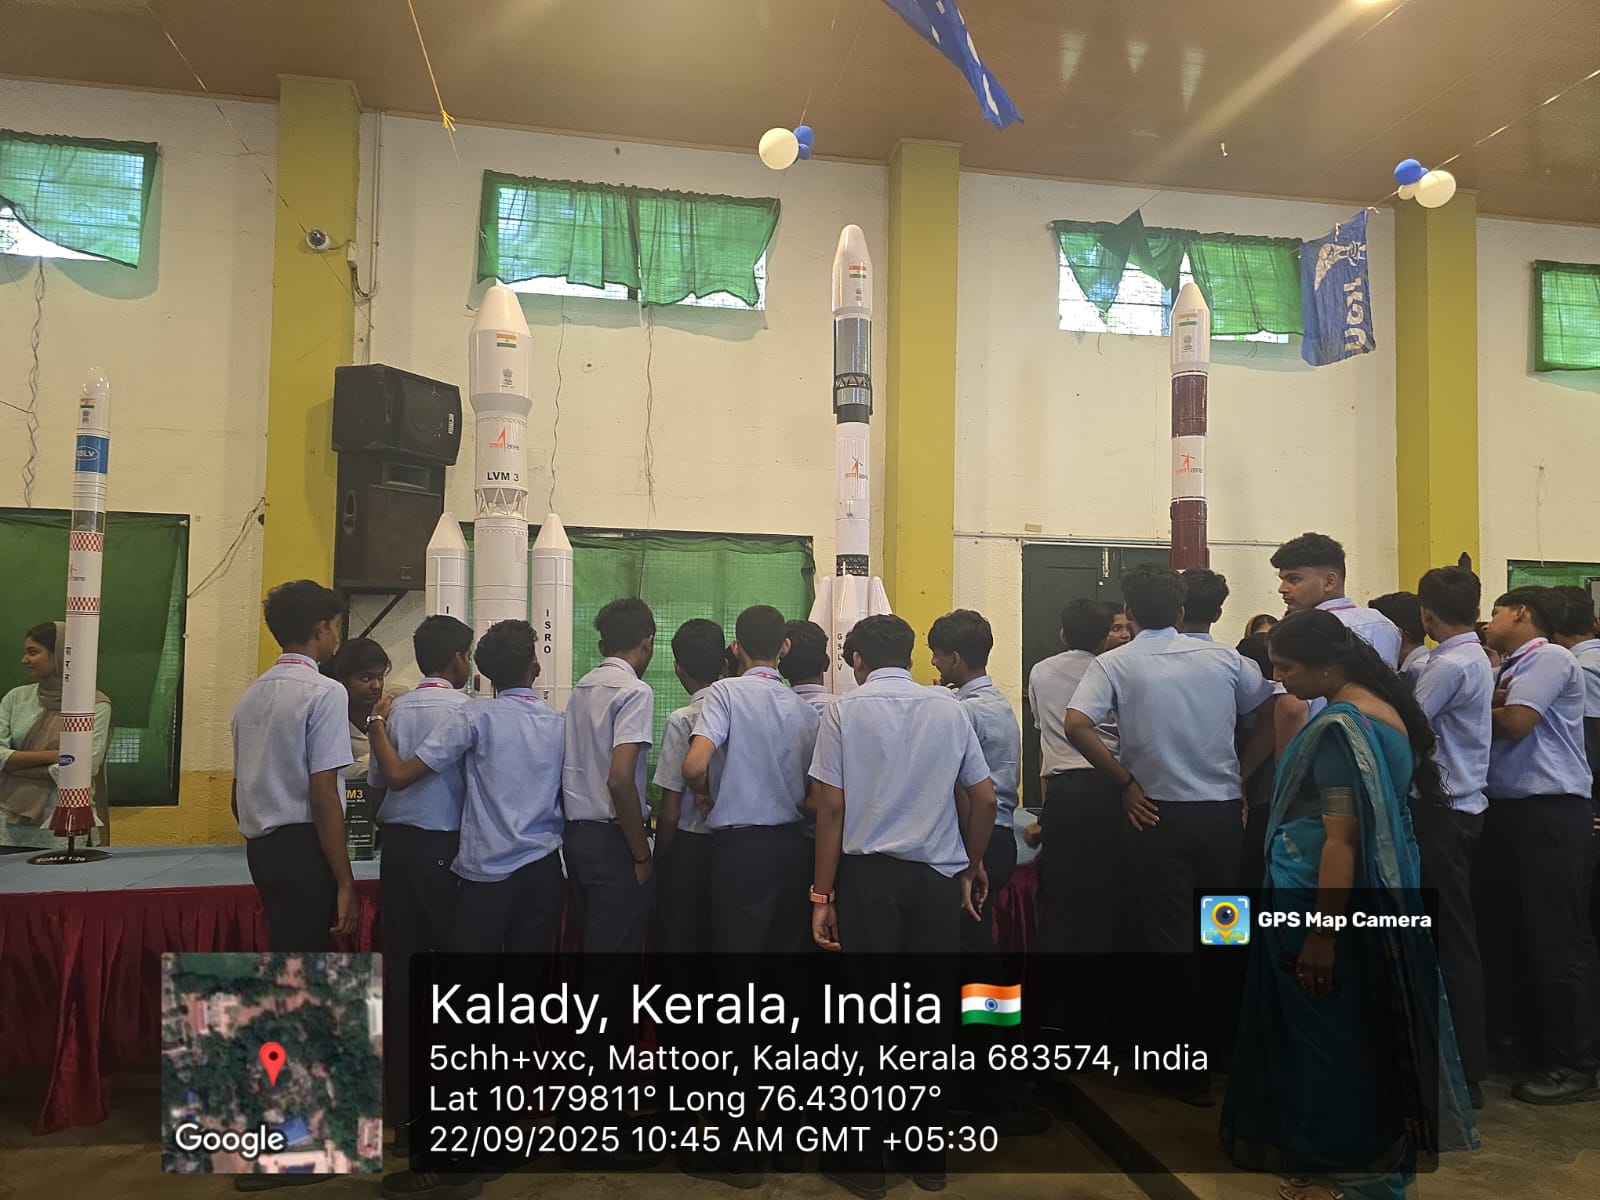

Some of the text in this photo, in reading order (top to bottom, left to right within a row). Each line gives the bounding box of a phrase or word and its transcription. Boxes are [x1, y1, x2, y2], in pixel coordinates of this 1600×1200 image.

[487, 471, 519, 482] LVM 3
[543, 608, 552, 654] ISRO
[346, 789, 364, 799] M3
